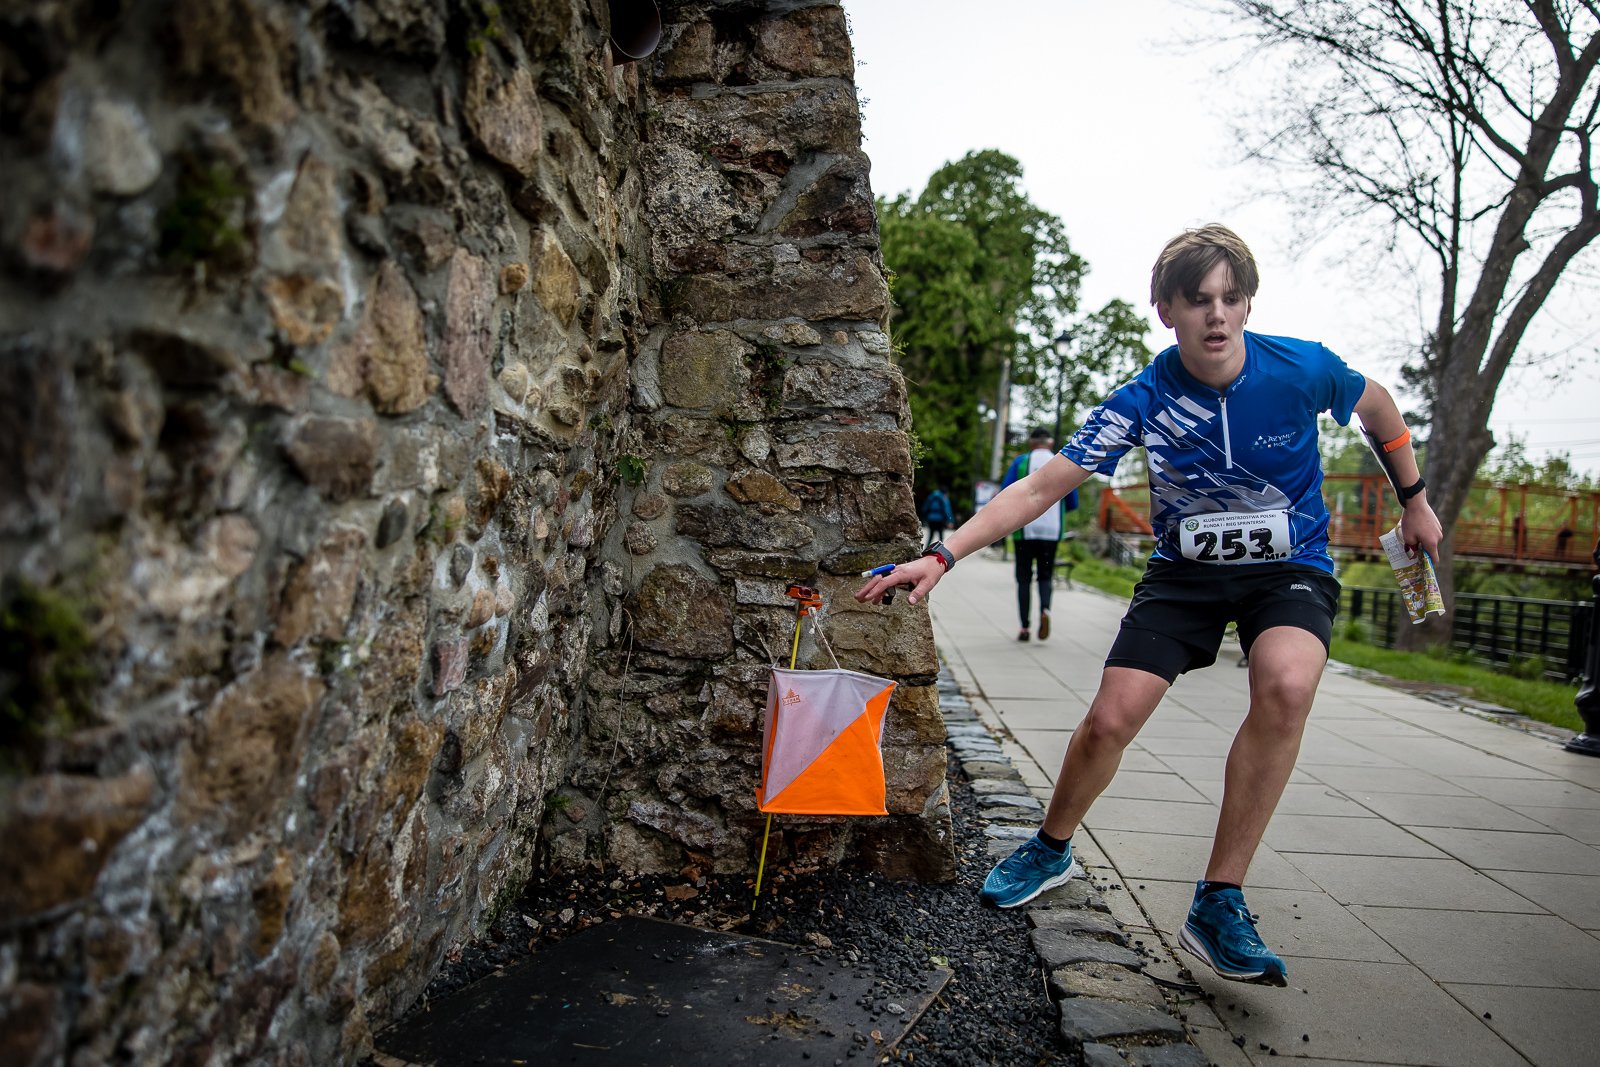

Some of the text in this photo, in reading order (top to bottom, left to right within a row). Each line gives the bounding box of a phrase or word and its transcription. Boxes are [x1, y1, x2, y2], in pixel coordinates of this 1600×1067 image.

[1267, 431, 1297, 443] AZYMUT
[1194, 528, 1274, 561] 253
[1264, 552, 1287, 561] M14
